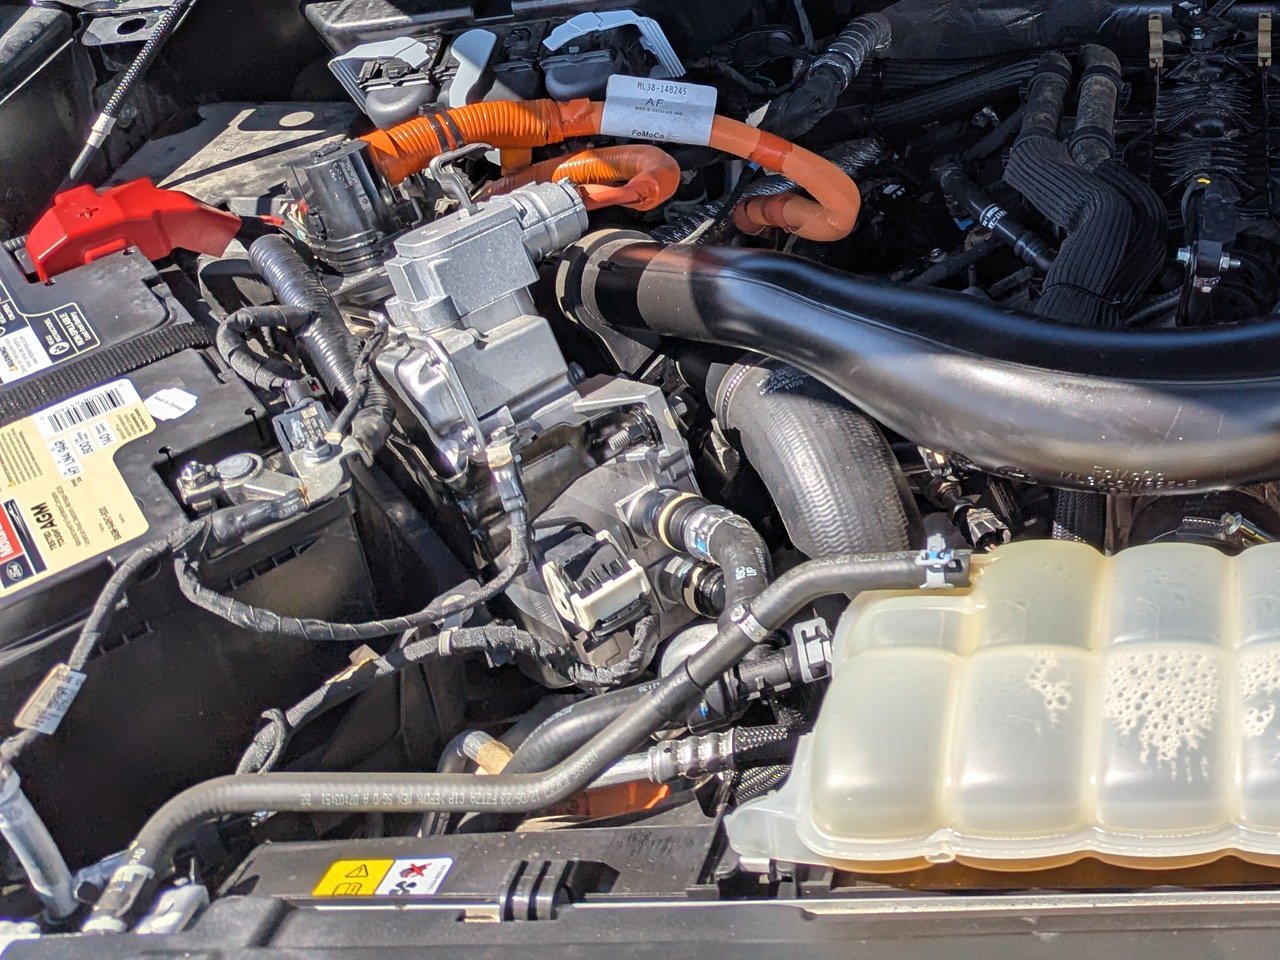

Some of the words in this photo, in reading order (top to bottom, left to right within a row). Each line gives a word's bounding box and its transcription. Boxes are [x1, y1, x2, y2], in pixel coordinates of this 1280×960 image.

[637, 82, 687, 96] ML38-14B245
[645, 98, 665, 106] AF
[632, 130, 665, 139] FoMoCo
[54, 440, 68, 452] 94R
[100, 434, 113, 446] 140
[79, 442, 93, 455] 800
[61, 452, 75, 466] LN4
[67, 465, 80, 475] H7
[30, 502, 57, 530] AGM
[44, 531, 57, 550] TESTED
